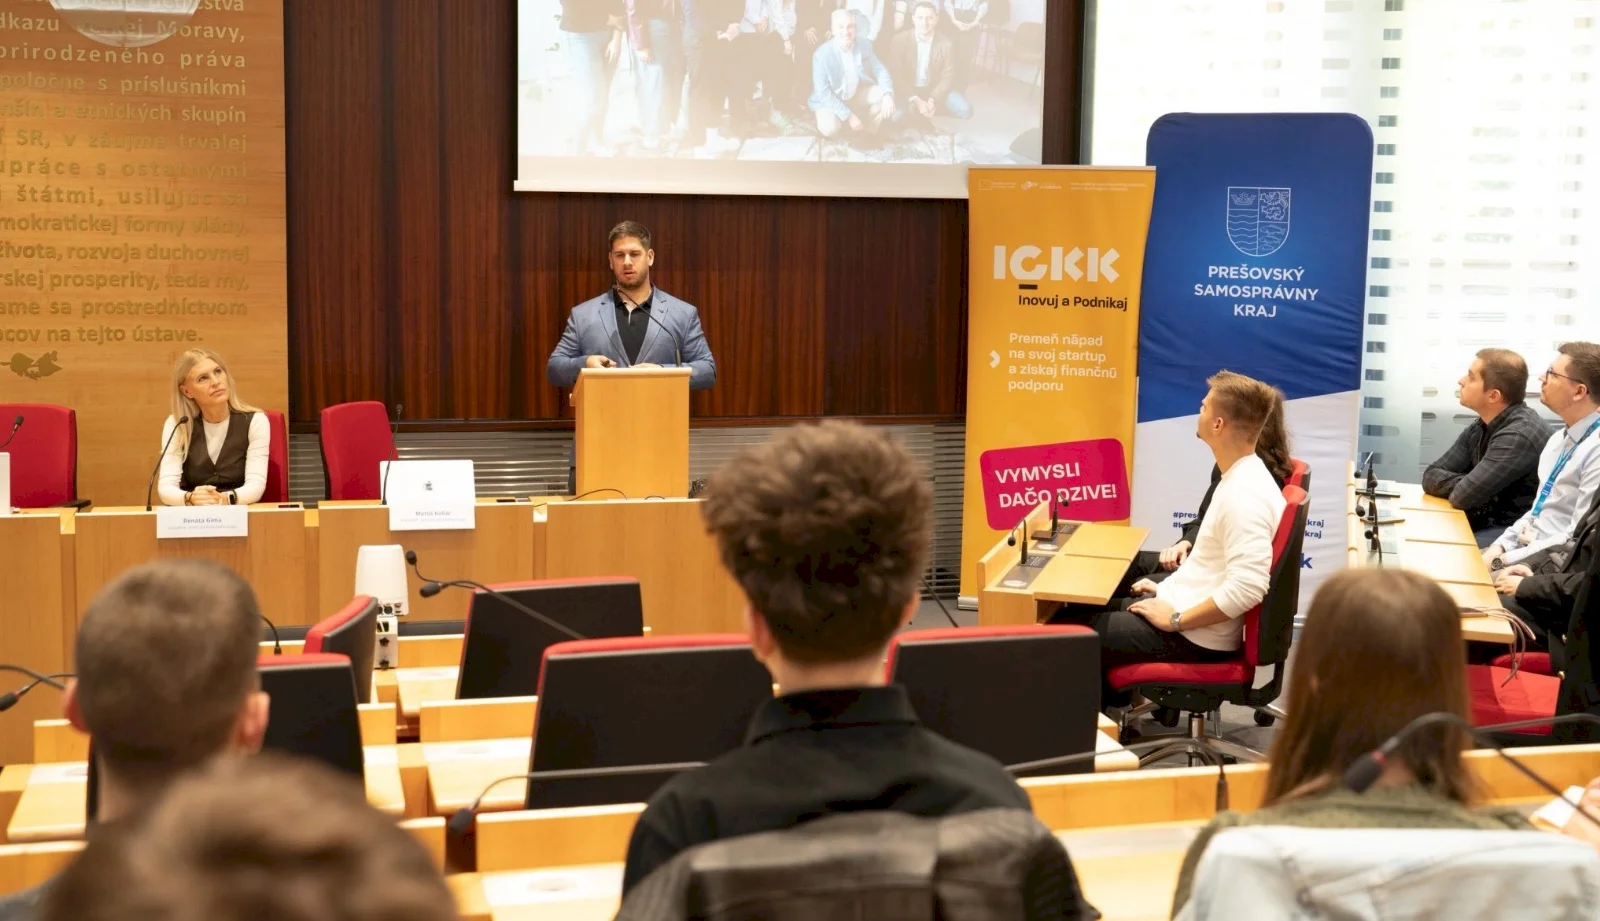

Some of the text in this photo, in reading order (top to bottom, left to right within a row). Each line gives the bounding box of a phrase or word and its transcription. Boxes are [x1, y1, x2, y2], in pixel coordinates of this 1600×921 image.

[180, 50, 246, 69] práva
[97, 78, 108, 91] s
[121, 75, 247, 95] príslušníkmi
[53, 106, 66, 118] a
[75, 102, 172, 124] etnických
[181, 105, 246, 127] skupín
[16, 129, 51, 149] SR,
[63, 134, 76, 147] v
[179, 134, 246, 153] trvalej
[96, 162, 107, 176] s
[17, 184, 104, 207] štátmi,
[124, 215, 184, 237] formy
[66, 242, 141, 263] rozvoja
[145, 243, 250, 265] duchovnej
[50, 271, 159, 291] prosperity,
[165, 273, 210, 288] teda
[216, 276, 250, 291] my,
[1208, 264, 1305, 281] PREŠOVSKÝ
[1194, 284, 1320, 301] SAMOSPRÁVNY
[50, 302, 72, 315] sa
[82, 297, 248, 319] prostredníctvom
[1019, 294, 1128, 312] Inovuj a Podnikaj
[1233, 304, 1277, 318] KRAJ
[47, 328, 71, 342] na
[77, 325, 126, 345] tejto
[132, 325, 203, 342] ústave.
[1009, 332, 1103, 348] Premeň nápad
[1009, 349, 1106, 364] na svoj startup
[1008, 365, 1017, 374] a
[1061, 364, 1117, 379] finančnú
[1008, 379, 1064, 393] podporu
[995, 462, 1080, 484] VYMYSLI
[999, 484, 1117, 508] DAČO DZIVE!
